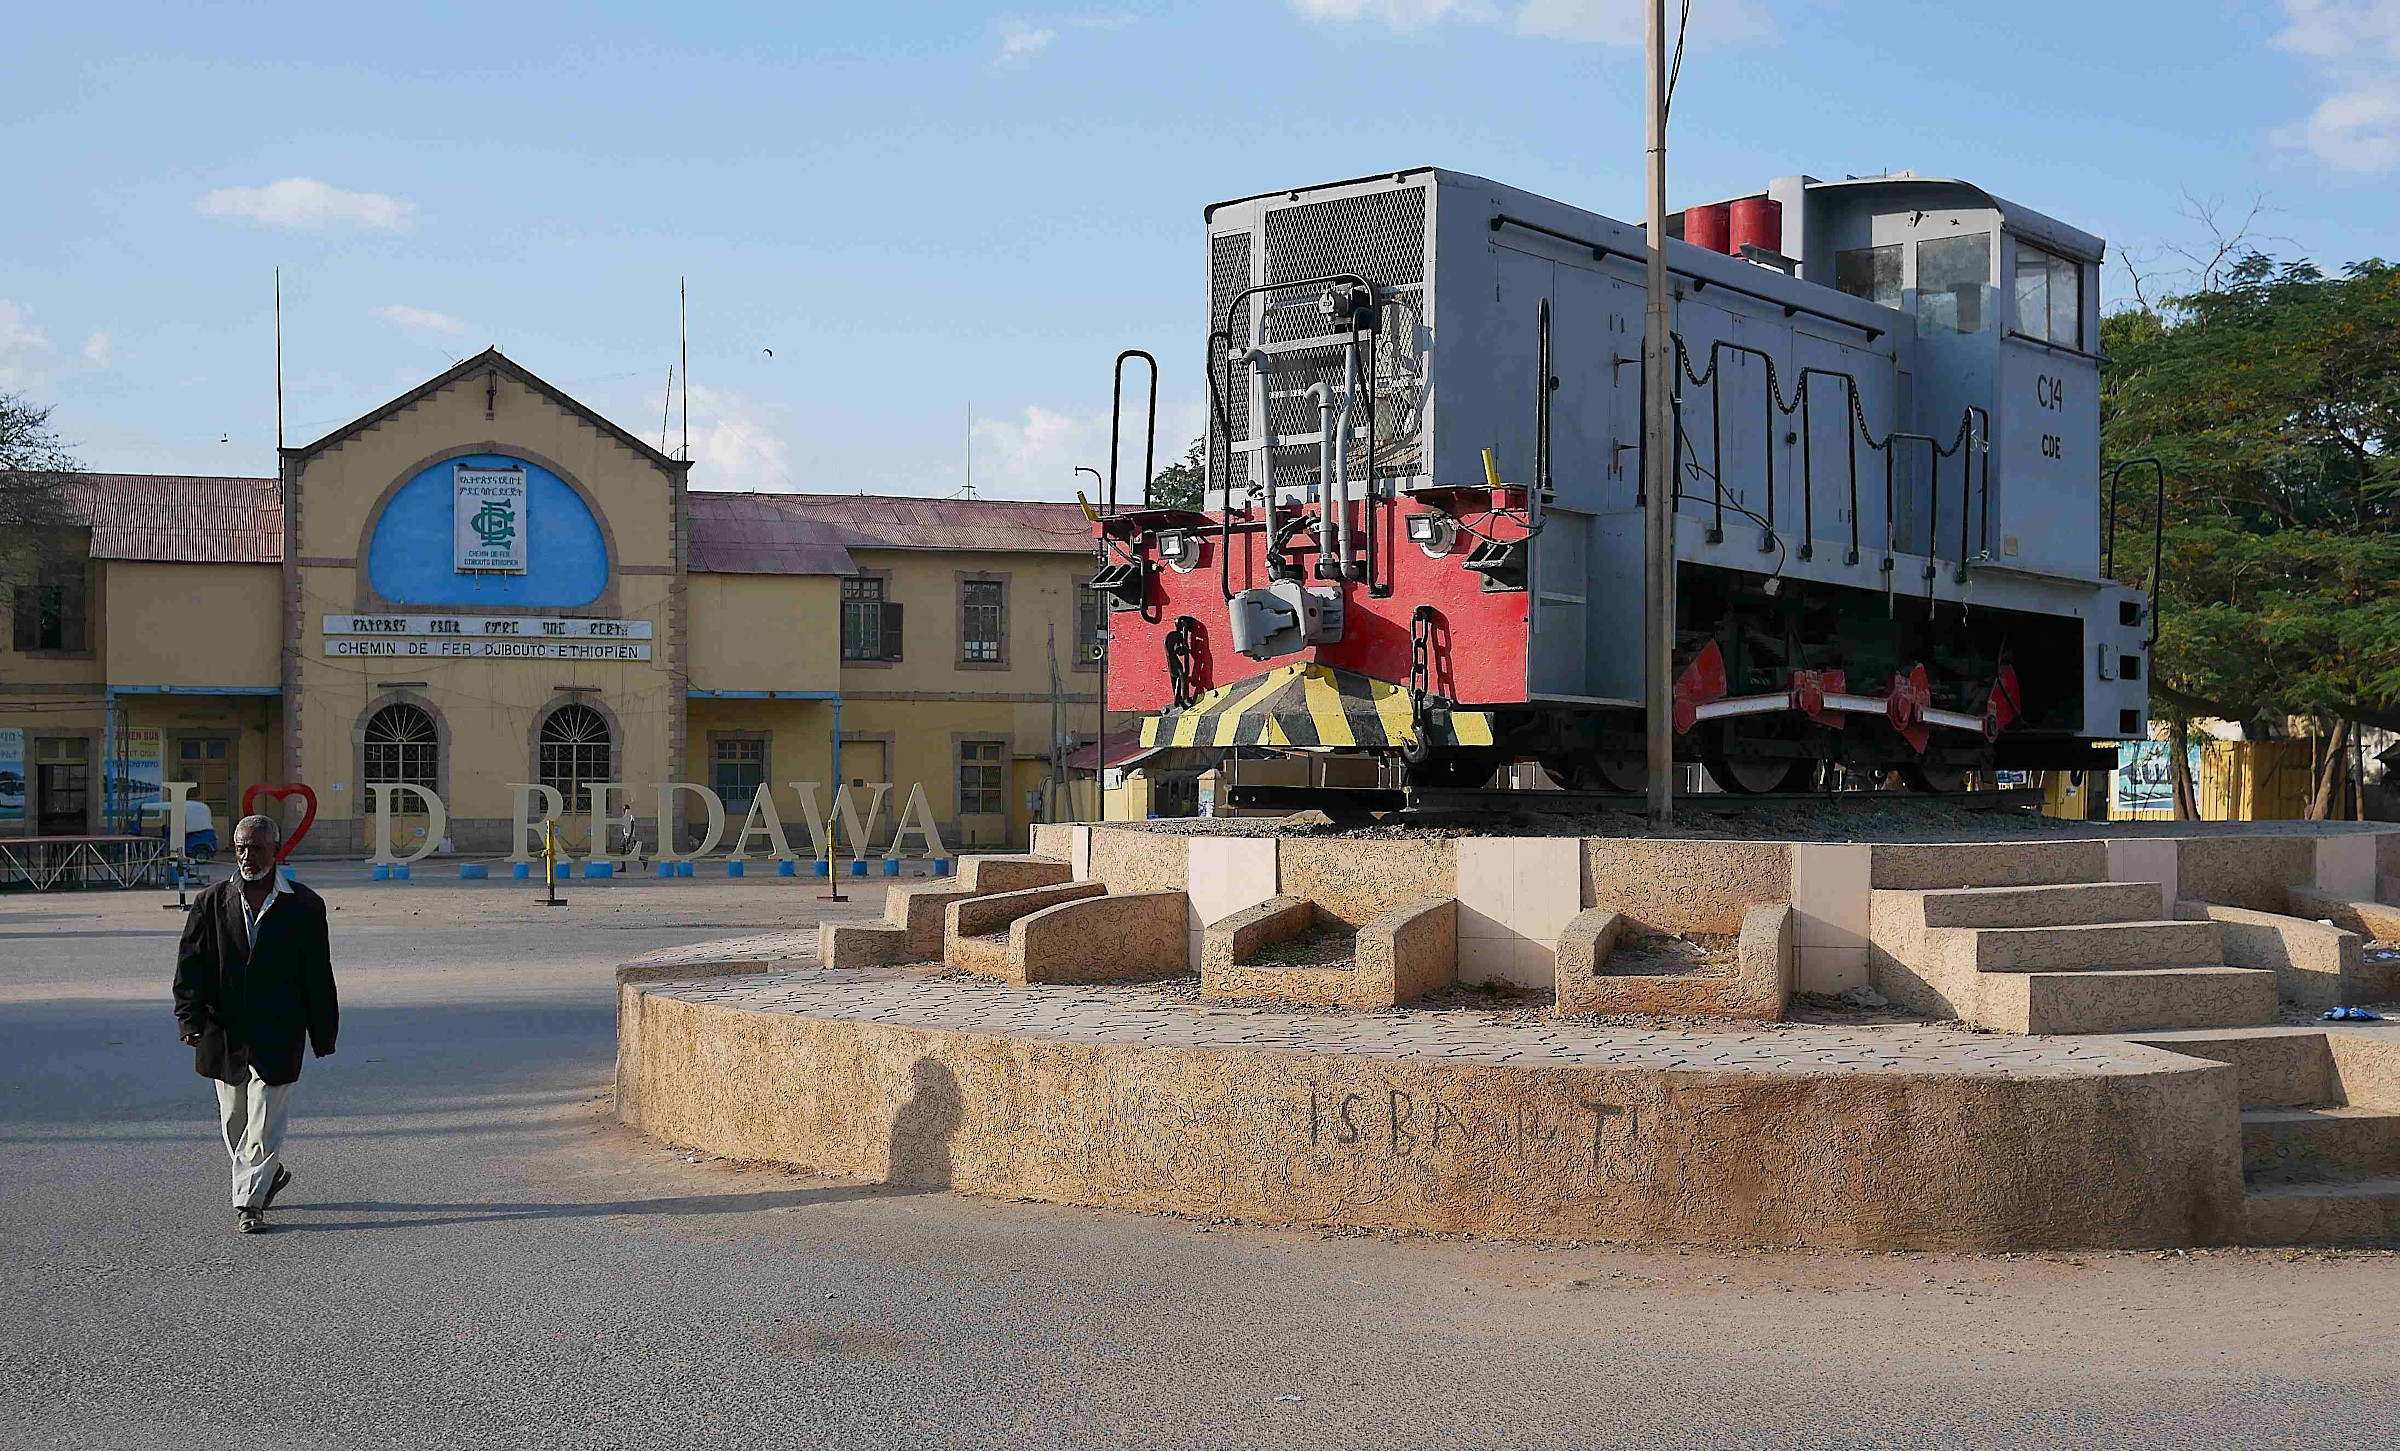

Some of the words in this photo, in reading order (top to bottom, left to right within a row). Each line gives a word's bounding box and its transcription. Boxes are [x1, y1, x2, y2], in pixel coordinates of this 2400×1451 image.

[2037, 374, 2063, 413] C14
[2042, 434, 2061, 460] CDE
[338, 642, 396, 655] CHEMIN
[408, 642, 428, 655] DE
[442, 643, 471, 655] FER
[162, 782, 197, 864] I
